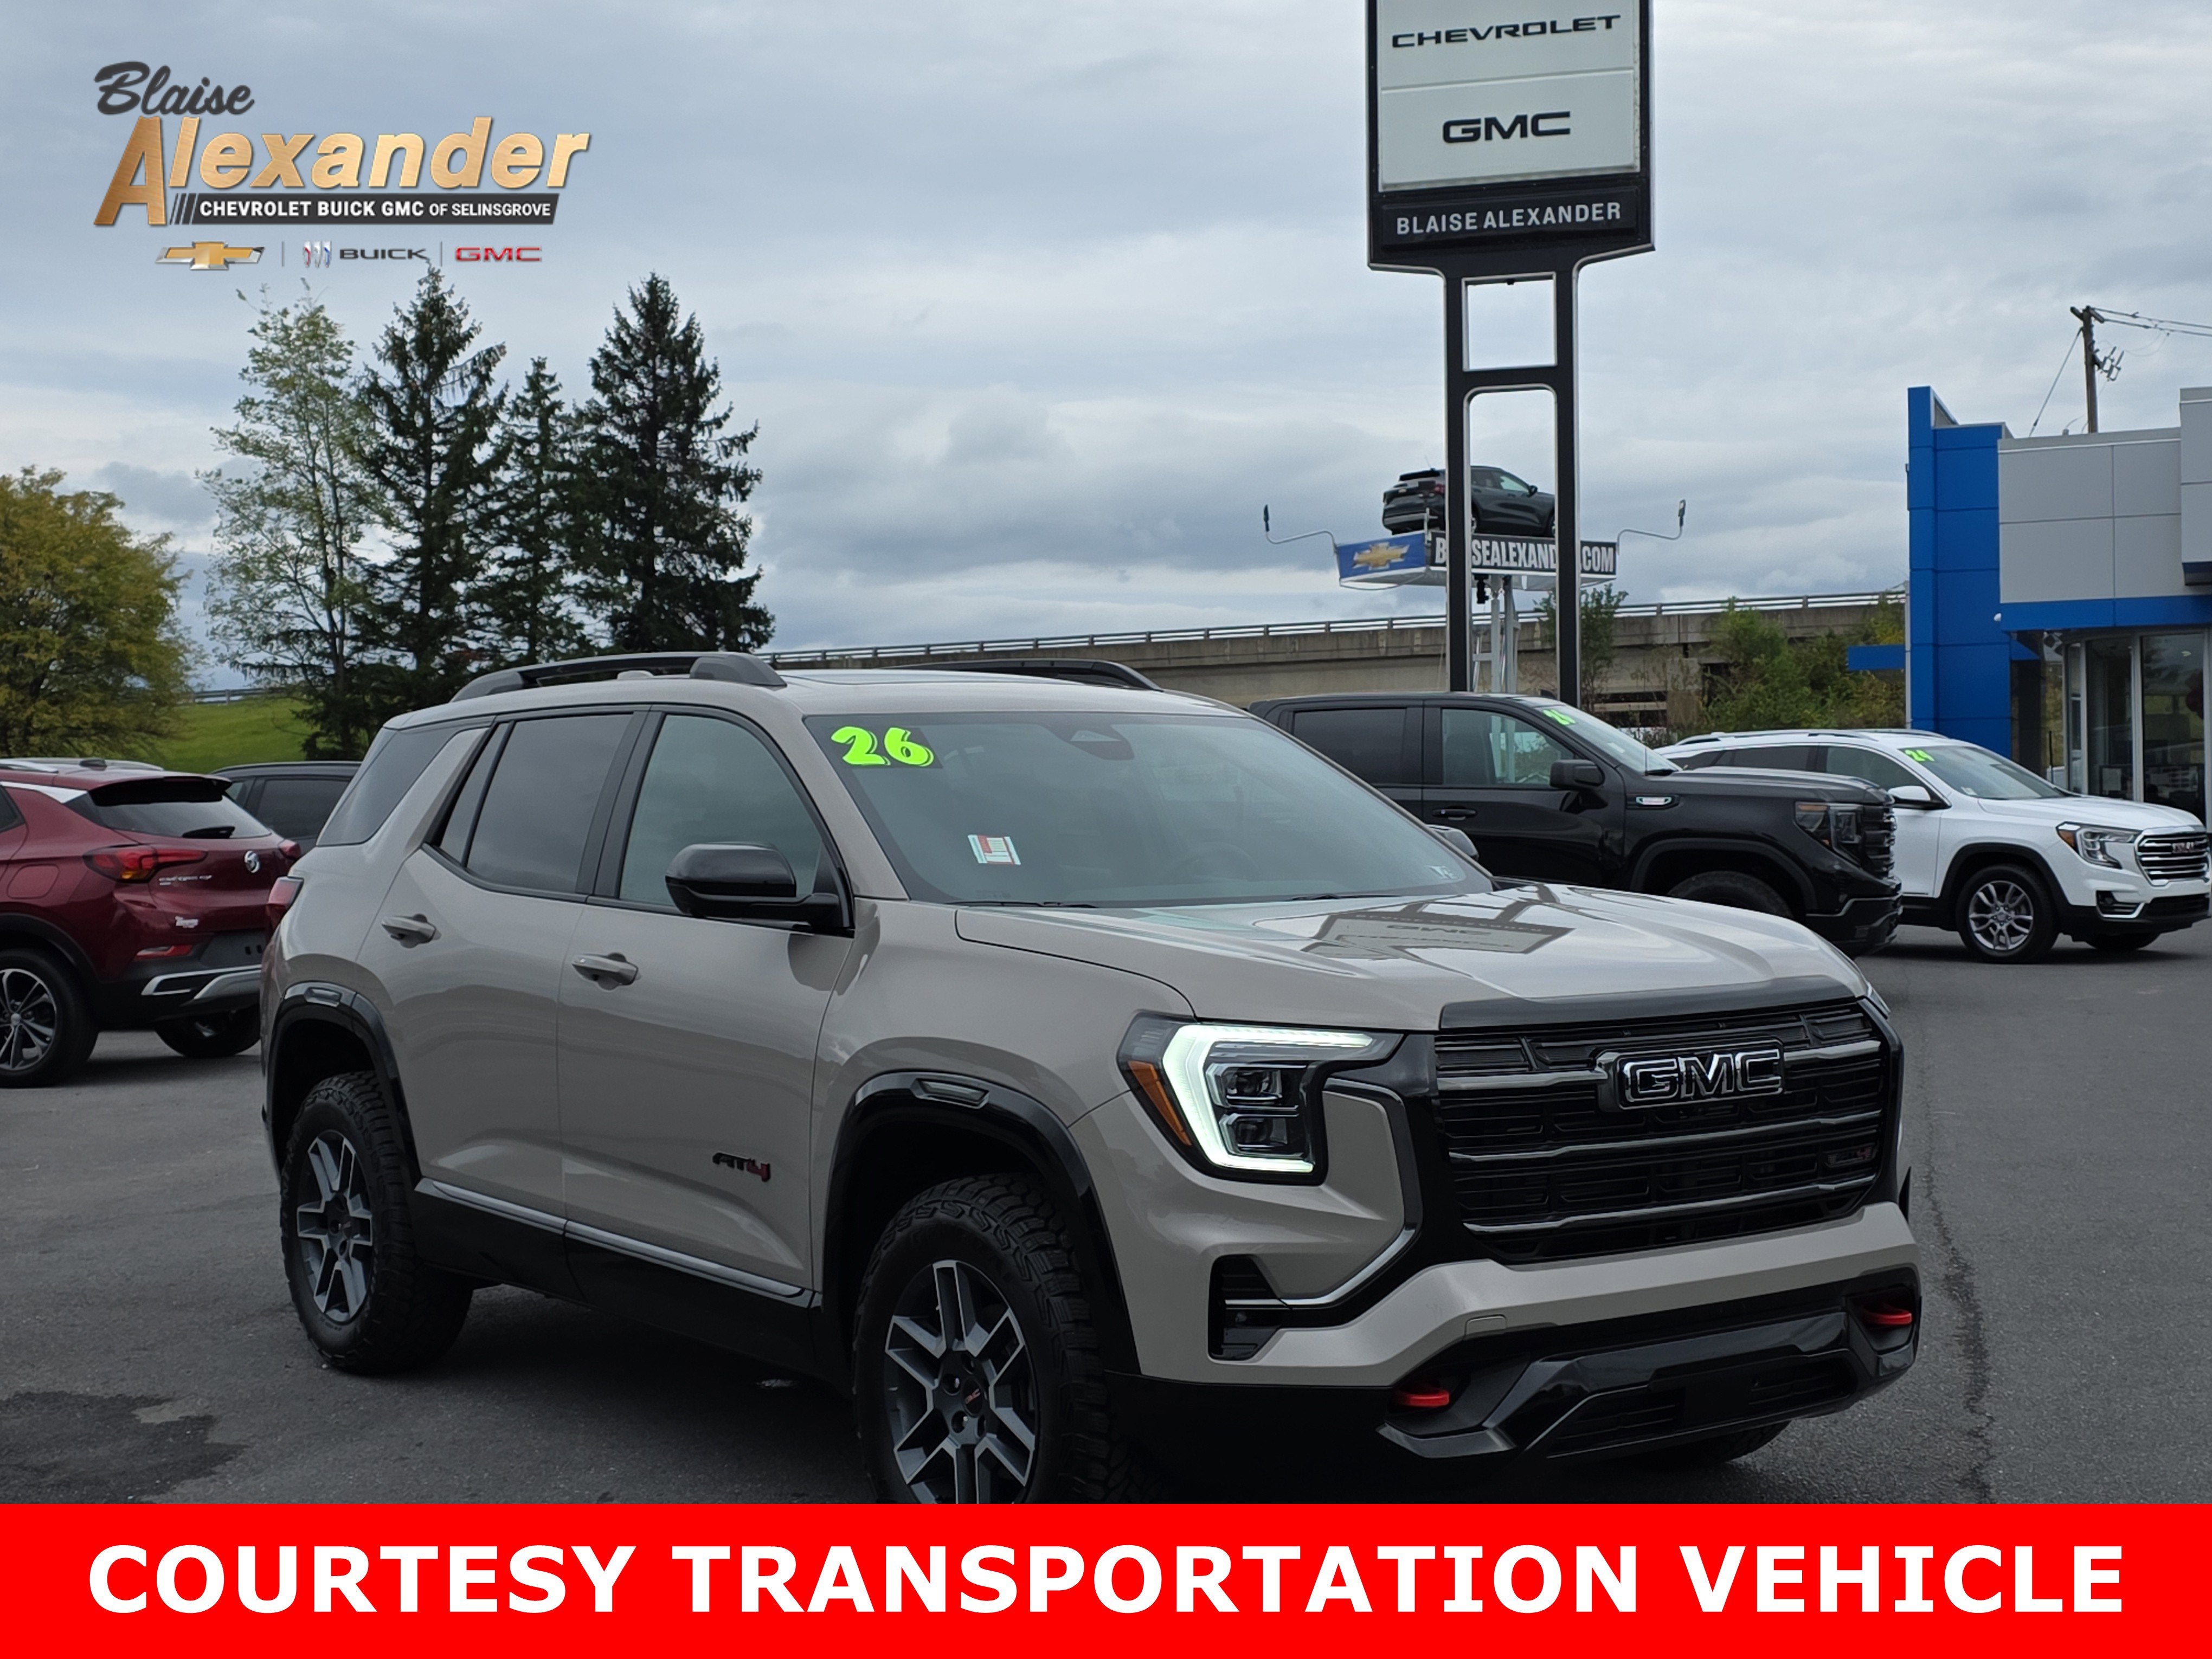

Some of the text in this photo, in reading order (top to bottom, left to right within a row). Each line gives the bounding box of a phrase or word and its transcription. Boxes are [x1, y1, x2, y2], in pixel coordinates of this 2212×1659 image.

[1392, 15, 1621, 48] CHEVROLET
[1442, 111, 1571, 144] GMC
[1397, 202, 1621, 235] BLAISE ALEXANDER
[831, 726, 935, 767] 26
[1624, 1049, 1783, 1103] GMC
[712, 1152, 771, 1182] AT4
